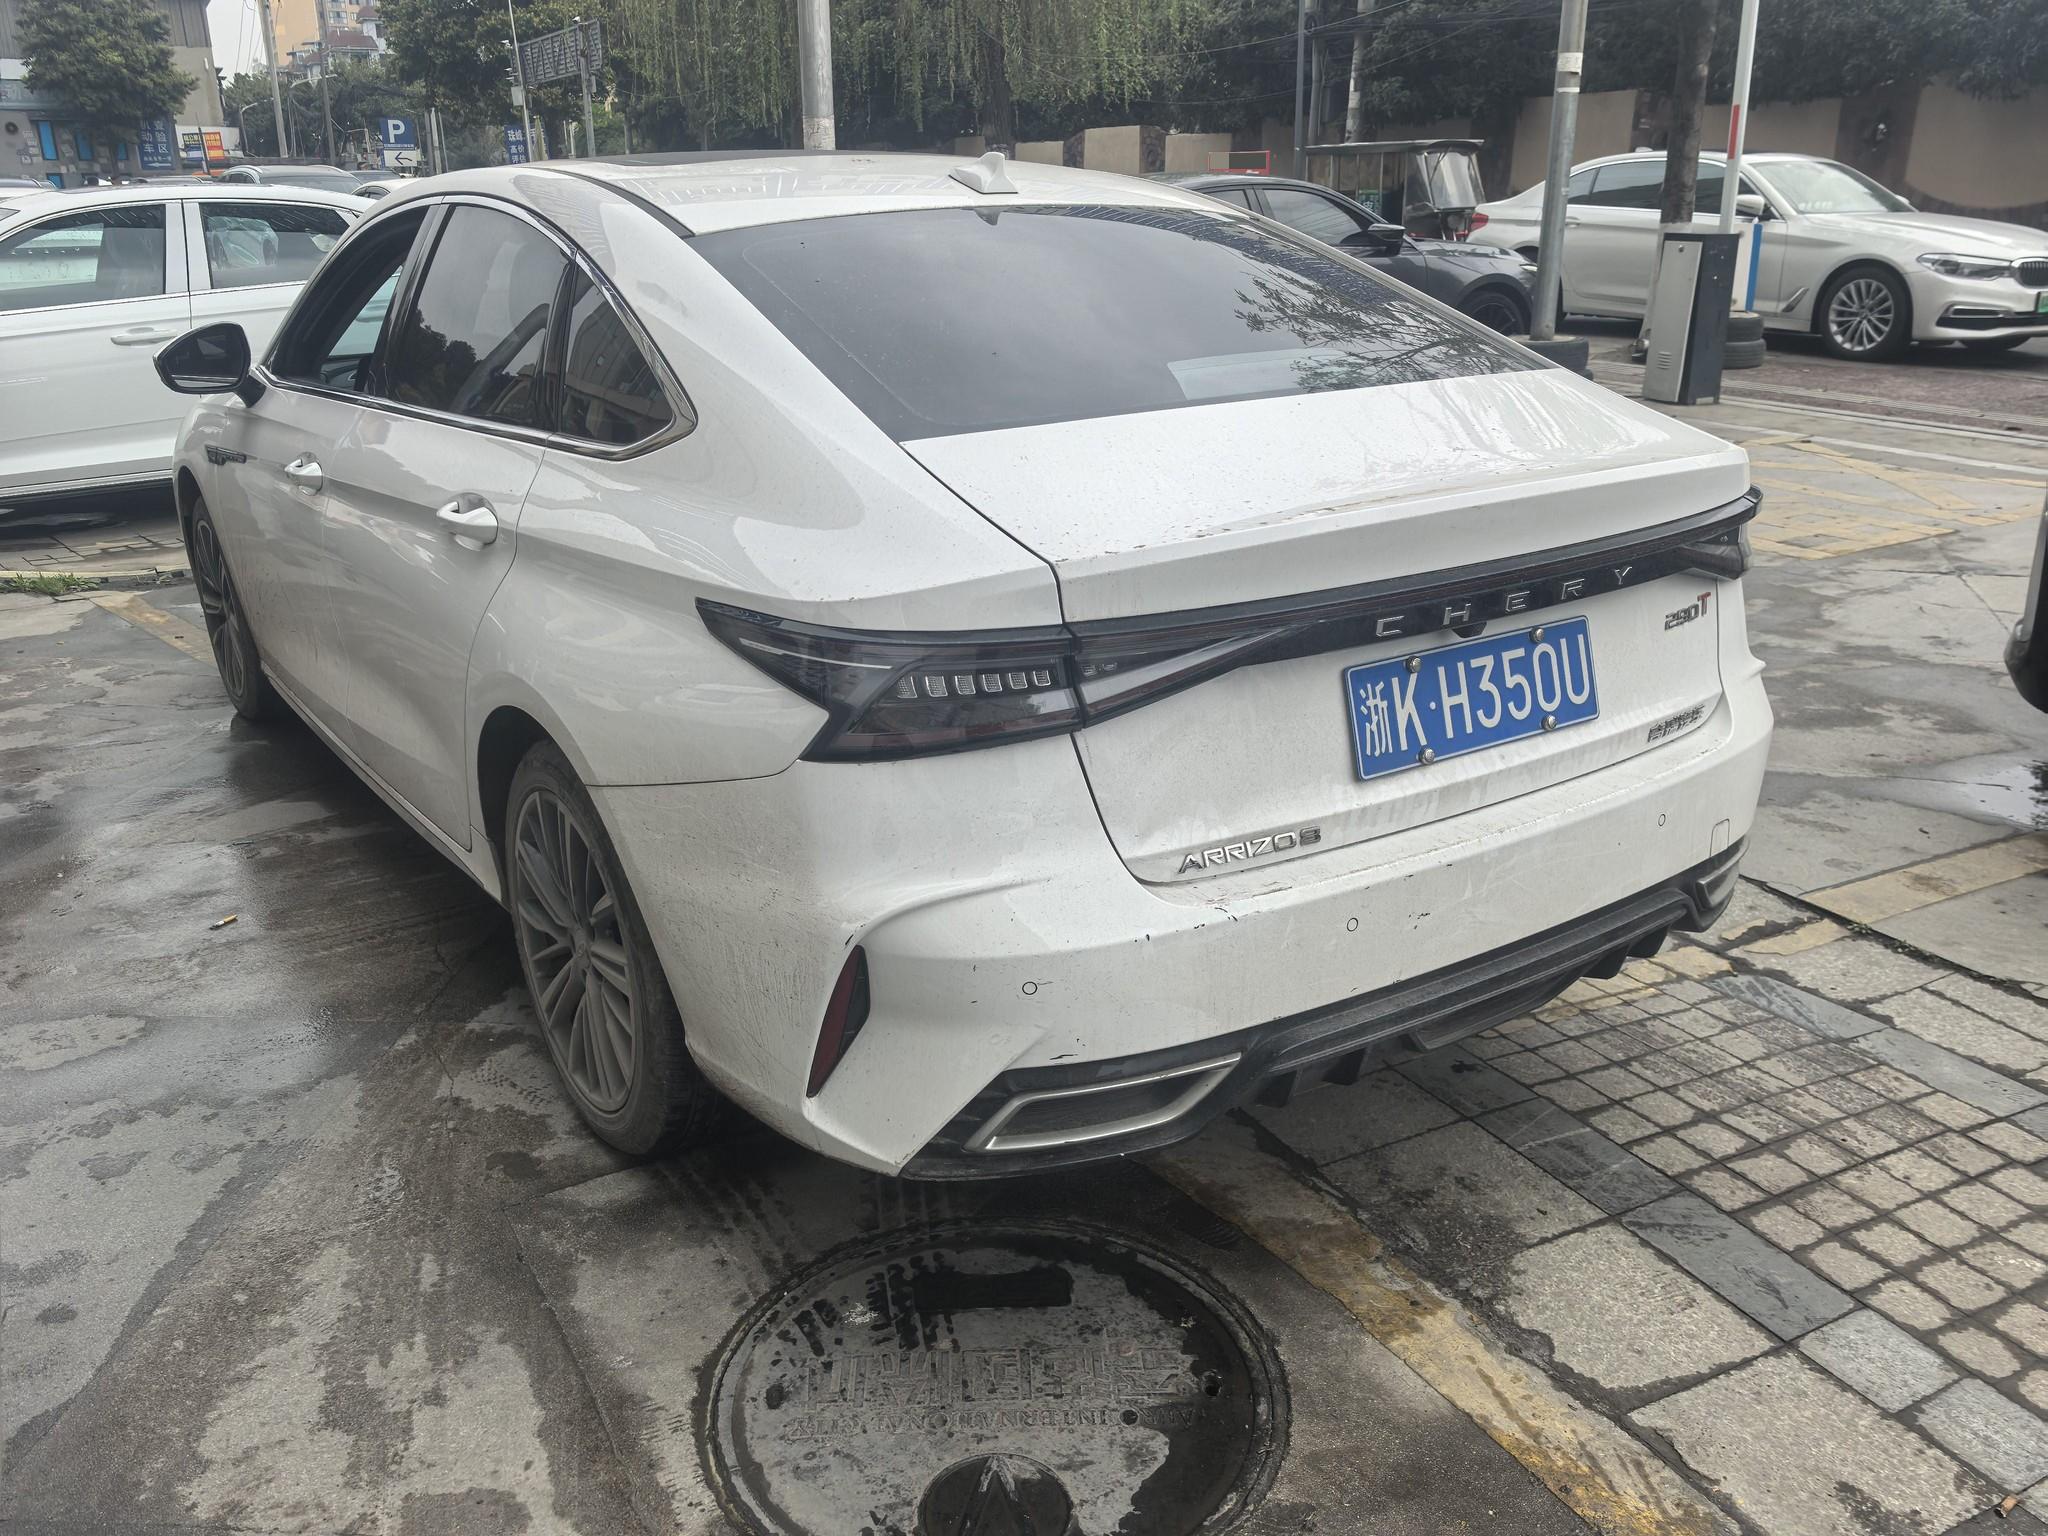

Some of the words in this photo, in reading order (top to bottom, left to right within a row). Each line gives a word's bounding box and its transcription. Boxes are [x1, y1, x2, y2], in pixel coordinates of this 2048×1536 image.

[387, 119, 406, 144] P
[1375, 565, 1633, 639] CHERY
[1177, 831, 1297, 875] ARRIZO
[1299, 825, 1322, 847] 8
